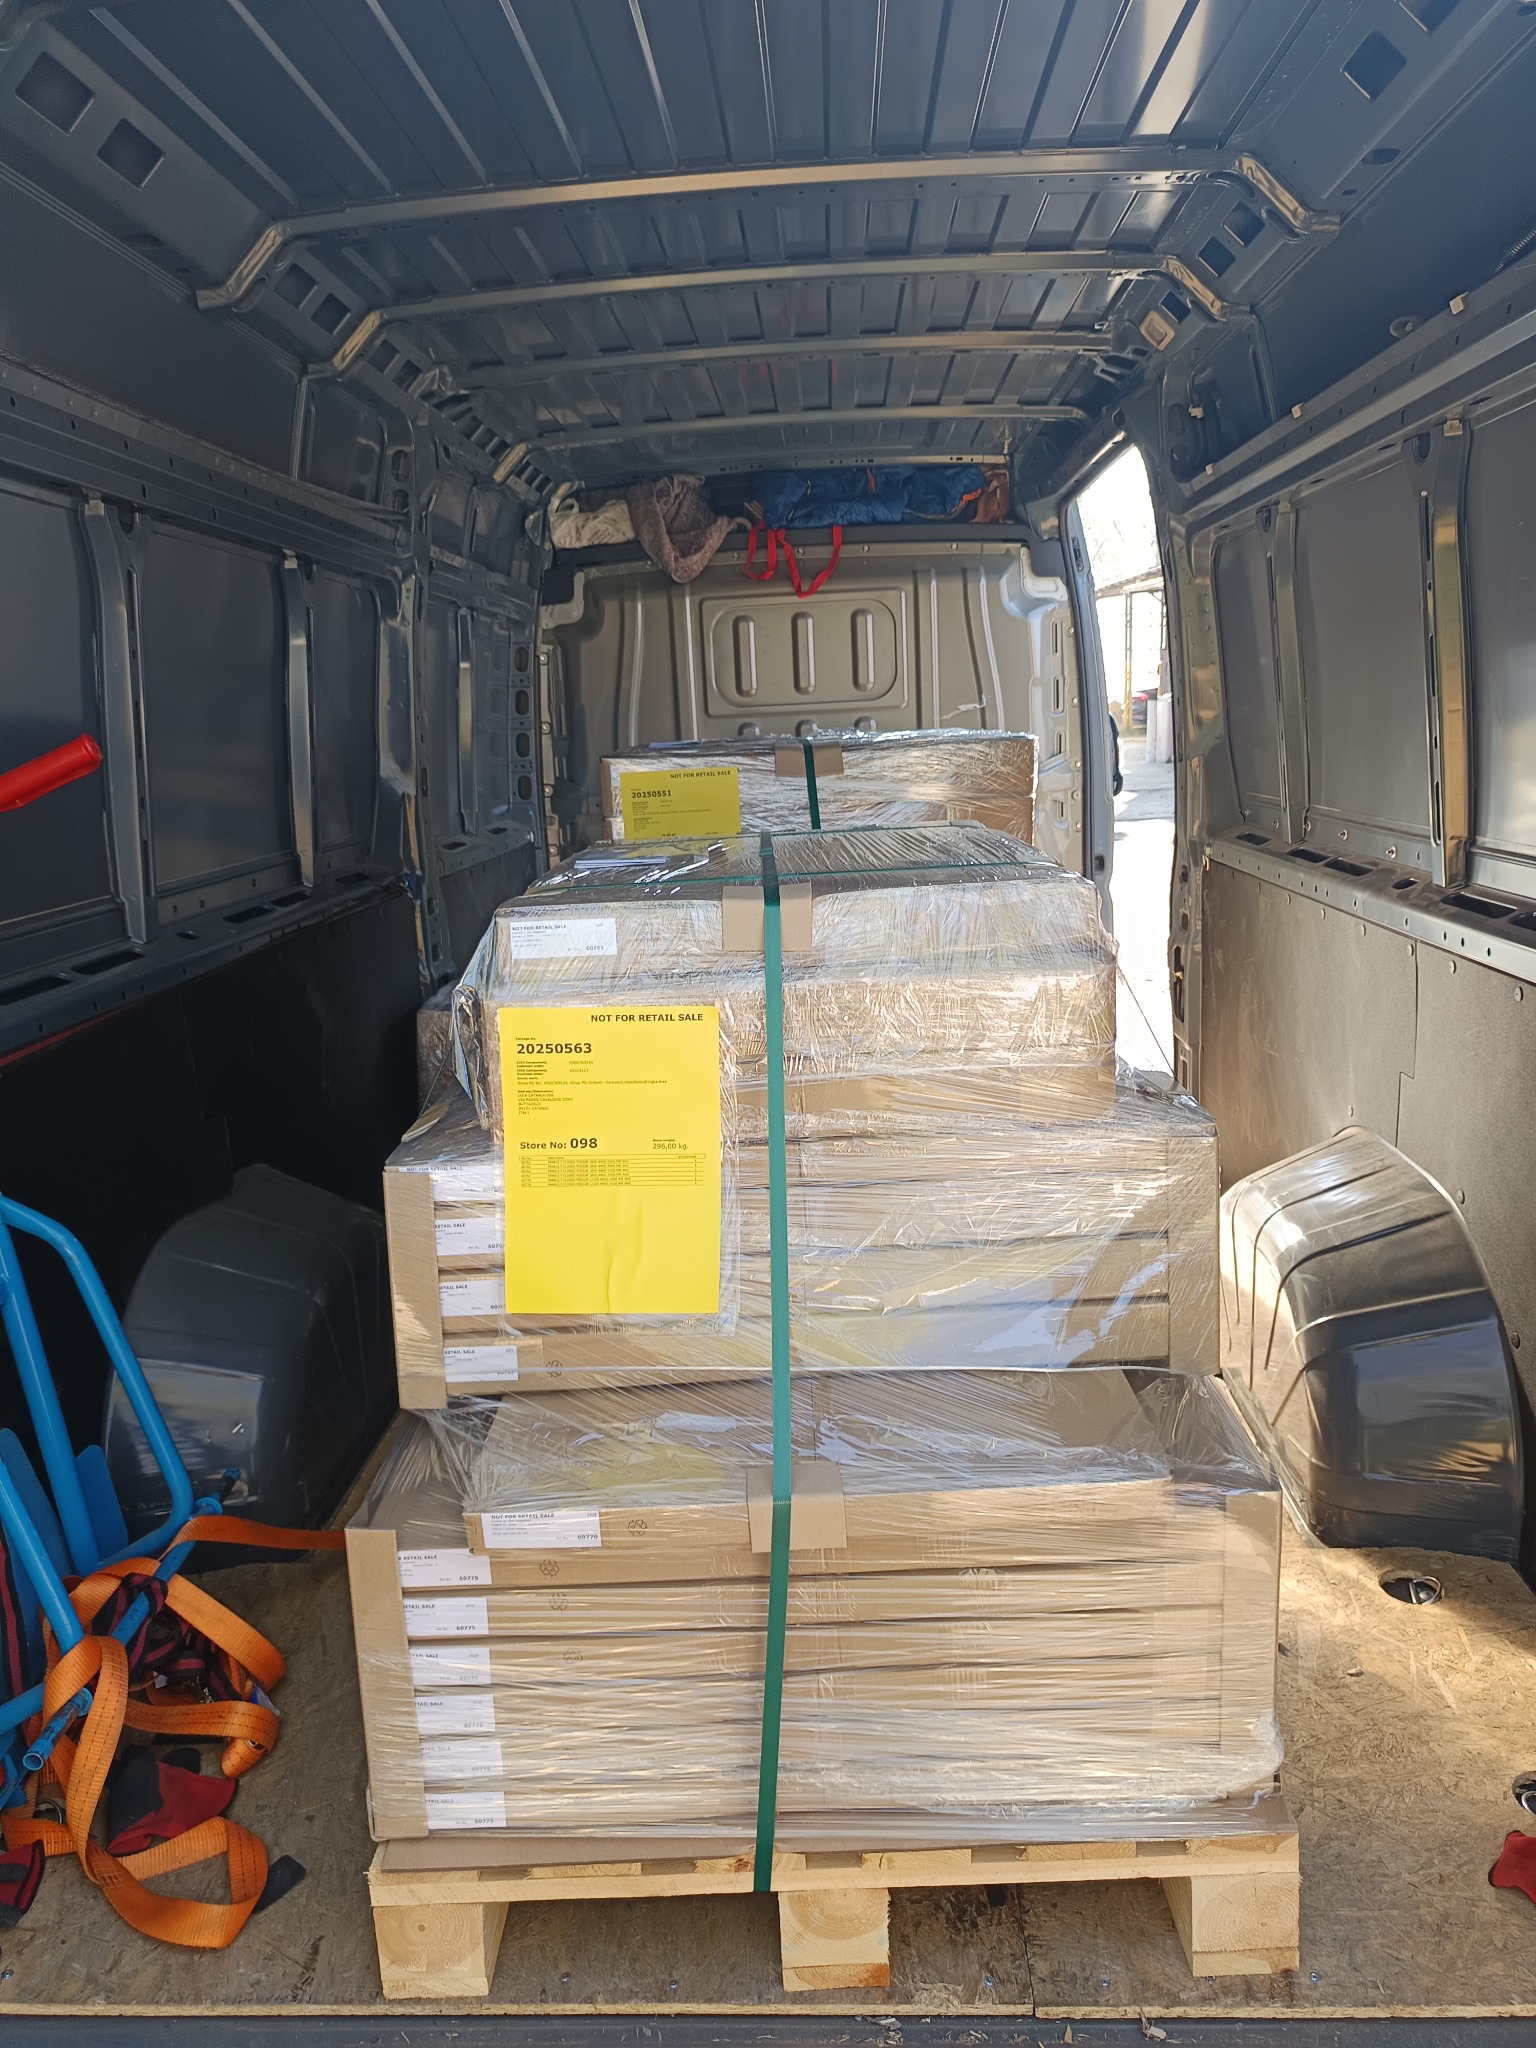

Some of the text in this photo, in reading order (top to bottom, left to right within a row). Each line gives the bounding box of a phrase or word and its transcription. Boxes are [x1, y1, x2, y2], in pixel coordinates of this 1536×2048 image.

[632, 790, 672, 798] 20250551
[591, 1013, 704, 1022] NOT FOR RETAIL SALE
[517, 1042, 592, 1054] 20250563
[570, 1138, 598, 1149] 098
